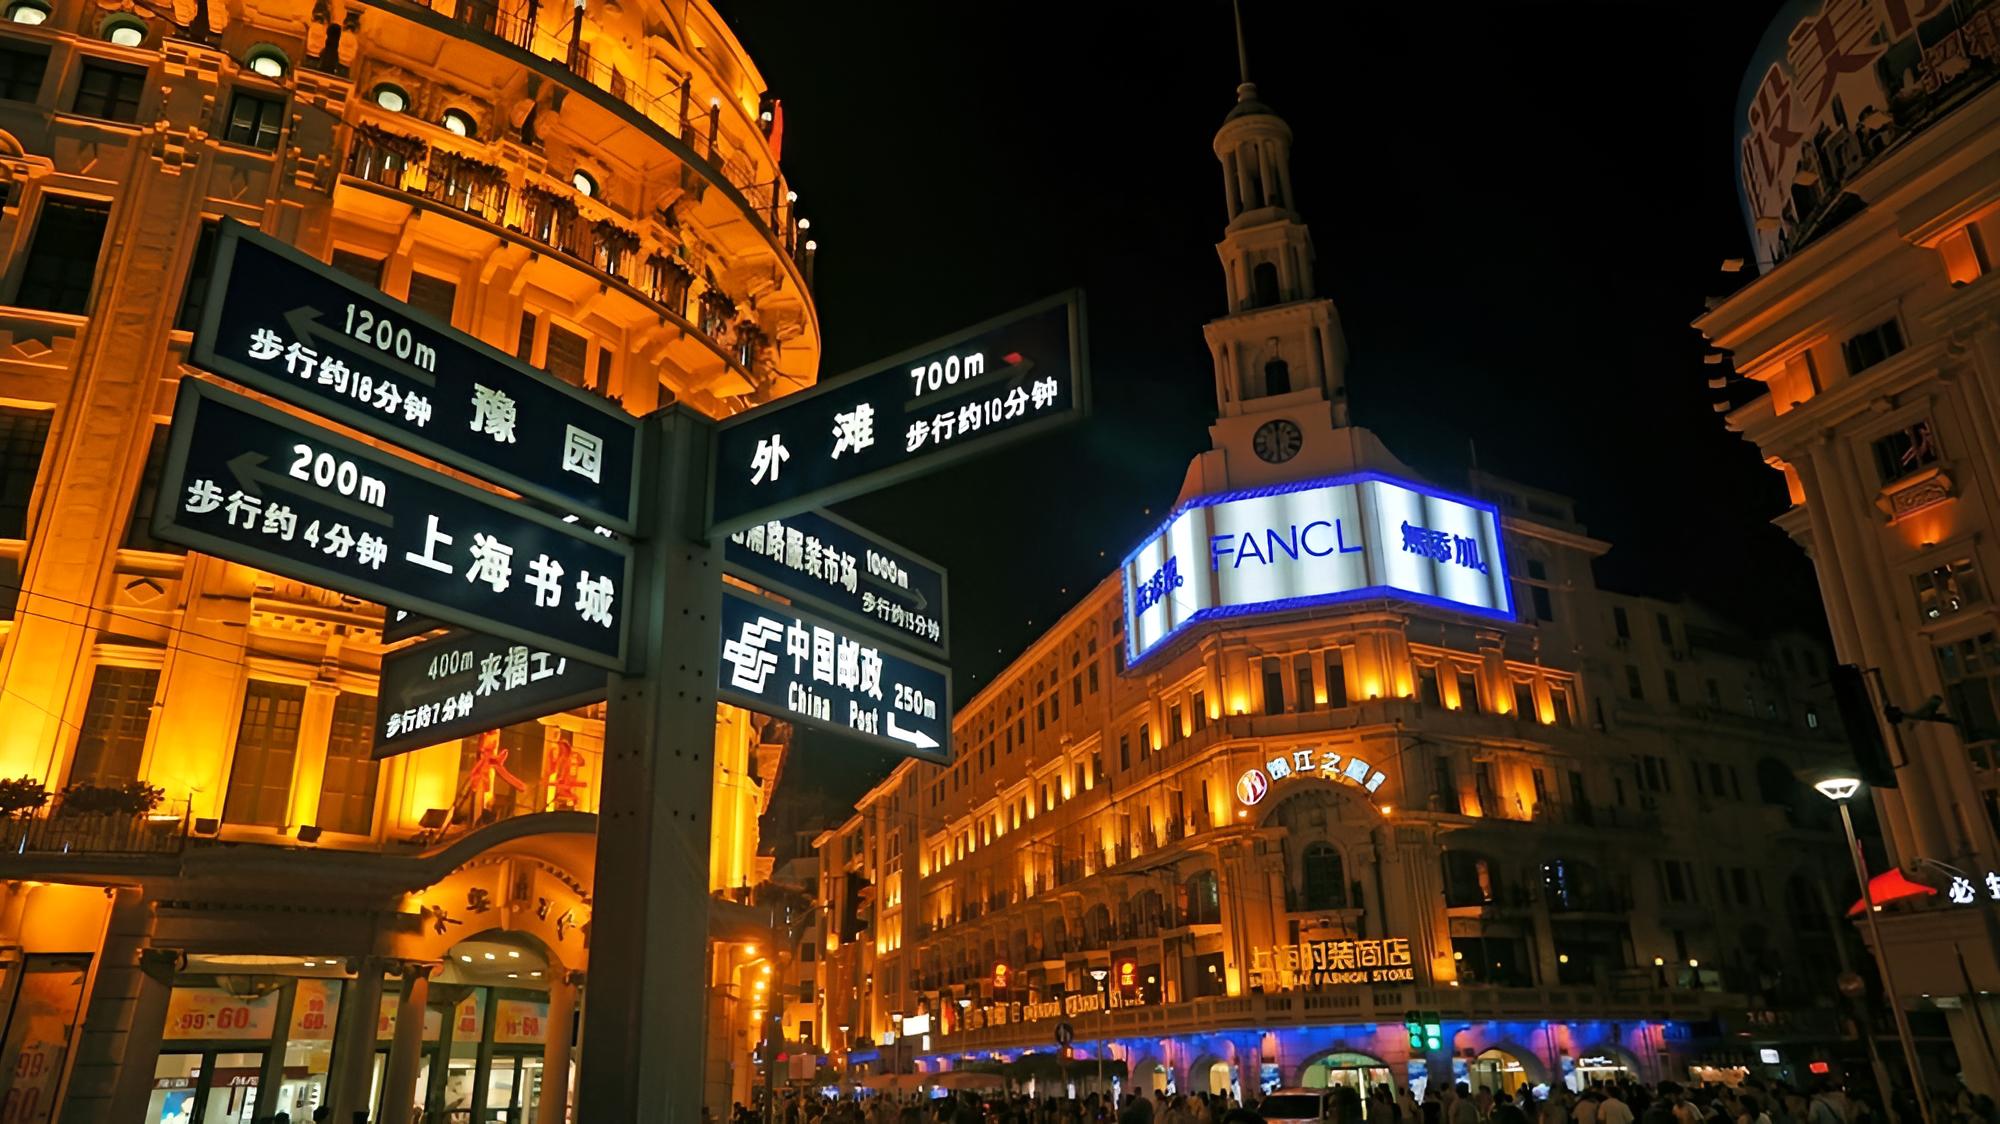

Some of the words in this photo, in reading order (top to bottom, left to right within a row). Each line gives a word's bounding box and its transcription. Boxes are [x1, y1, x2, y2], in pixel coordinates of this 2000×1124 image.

[345, 303, 436, 373] 1200m
[248, 328, 432, 428] 步行约18分钟
[910, 352, 984, 397] 700m
[470, 382, 603, 484] 豫园
[750, 402, 875, 486] 外滩
[905, 376, 1058, 453] 步行约10分钟
[288, 444, 386, 508] 200m
[185, 479, 388, 570] 步行约4分钟
[1209, 518, 1363, 573] FANCL
[405, 515, 615, 629] 上海书城
[866, 549, 909, 590] 1000m
[427, 650, 474, 681] 400m
[786, 618, 883, 702] 中国邮政
[385, 690, 474, 739] 步行约7分钟
[788, 680, 831, 722] China
[849, 699, 879, 736] Post
[894, 682, 937, 720] 250m
[216, 1006, 250, 1030] 60
